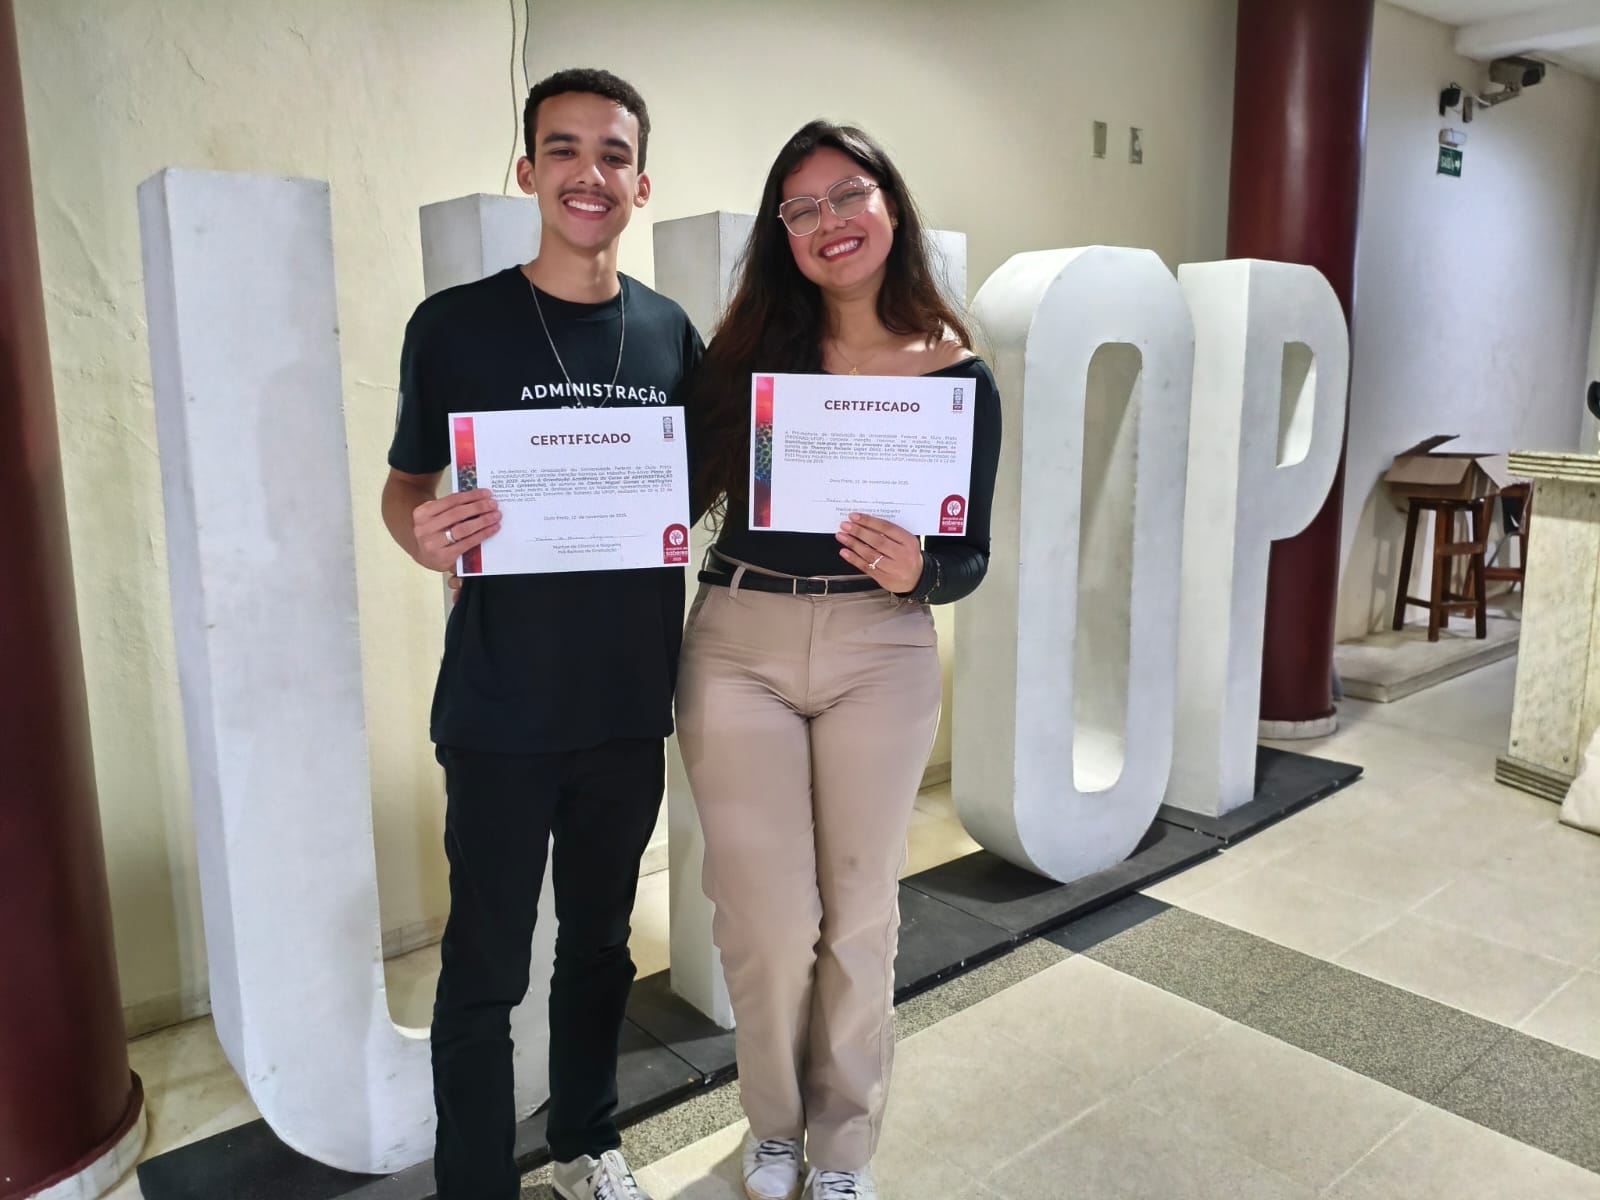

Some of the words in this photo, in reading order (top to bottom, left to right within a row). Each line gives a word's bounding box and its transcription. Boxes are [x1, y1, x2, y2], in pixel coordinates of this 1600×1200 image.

[520, 382, 667, 405] ADMINISTRAÇÃO
[824, 400, 921, 412] CERTIFICADO
[530, 432, 631, 446] CERTIFICADO
